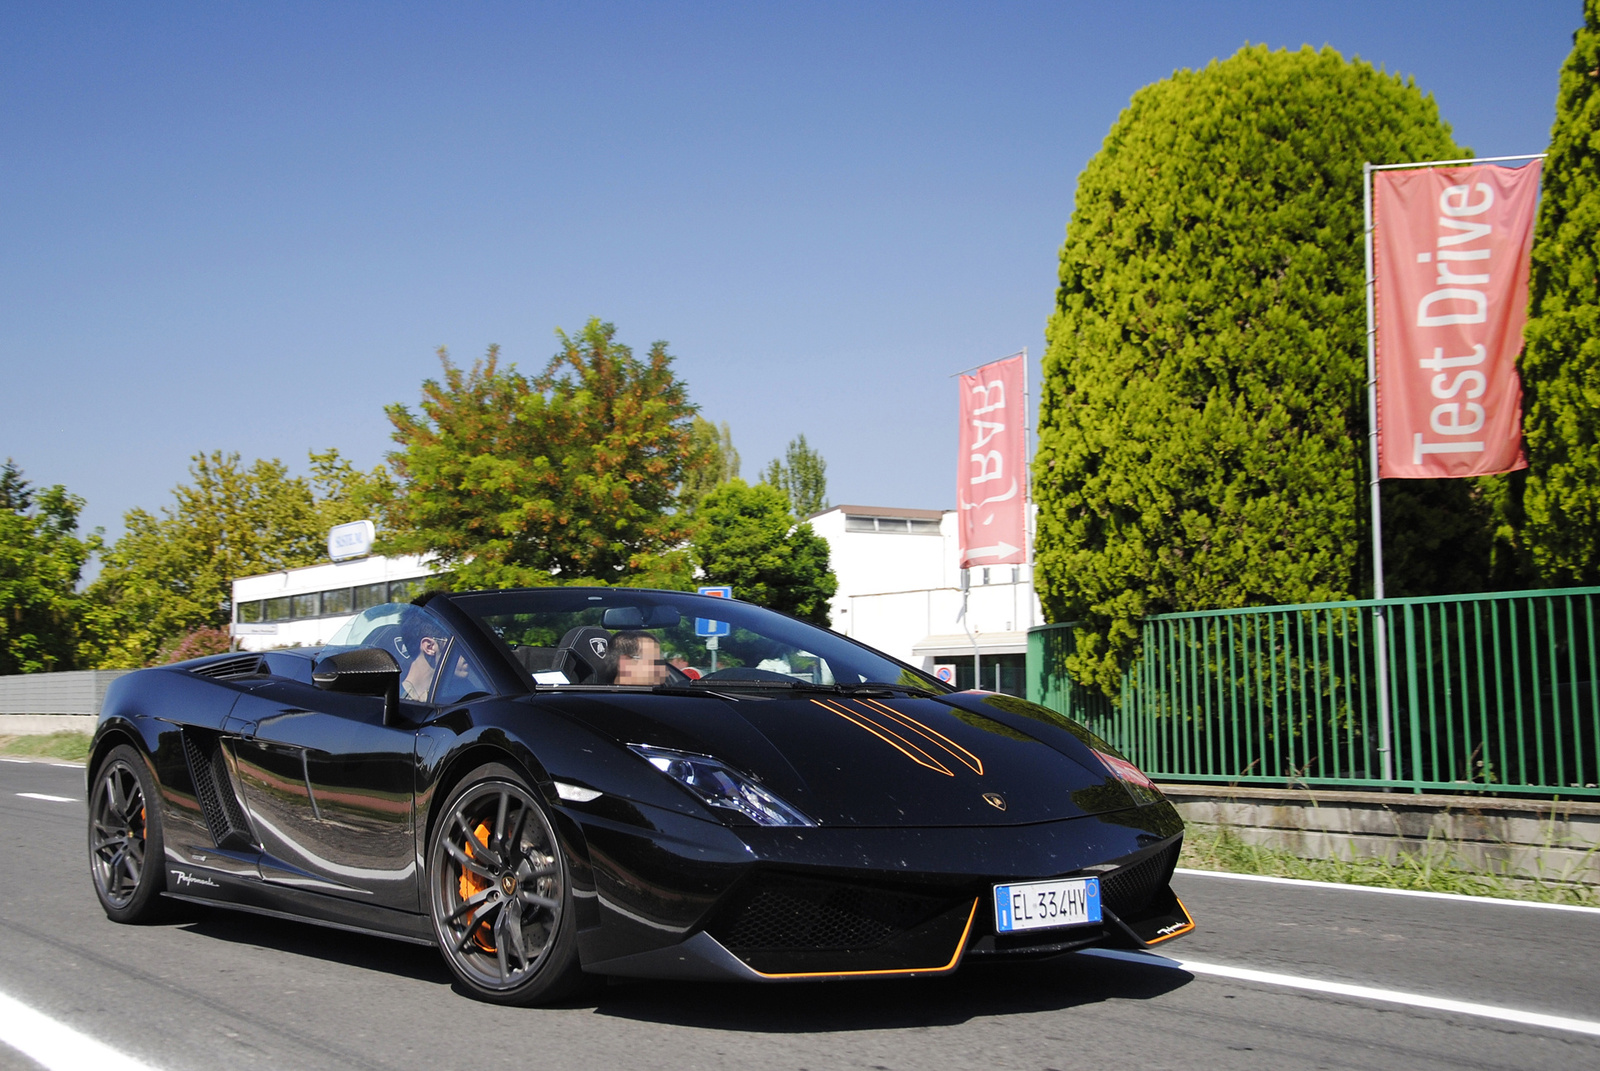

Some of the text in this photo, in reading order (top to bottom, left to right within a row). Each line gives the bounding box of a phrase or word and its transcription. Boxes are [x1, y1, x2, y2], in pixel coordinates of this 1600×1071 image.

[1412, 181, 1495, 465] Test Drive
[1013, 888, 1086, 920] EL 334HV
